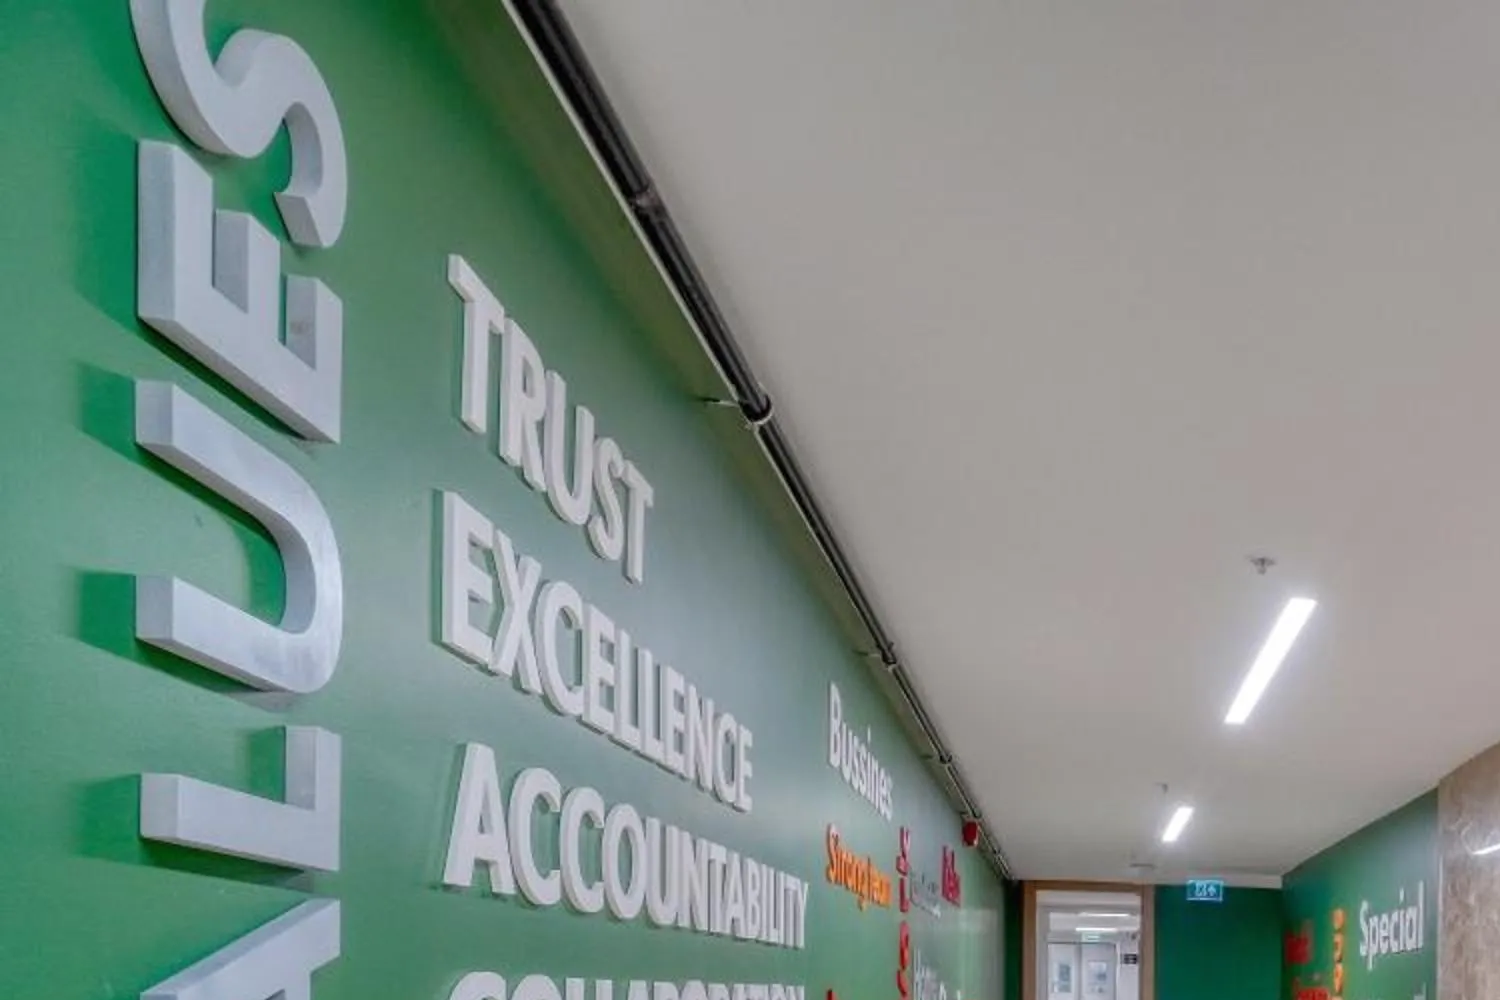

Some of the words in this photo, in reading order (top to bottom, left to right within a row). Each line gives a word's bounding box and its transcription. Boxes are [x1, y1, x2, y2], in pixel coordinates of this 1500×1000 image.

[448, 253, 653, 584] TRUST
[441, 491, 752, 813] EXCELLENCE
[829, 682, 893, 821] Bussines
[442, 743, 809, 949] ACCOUNTABILITY
[1359, 880, 1424, 971] Special
